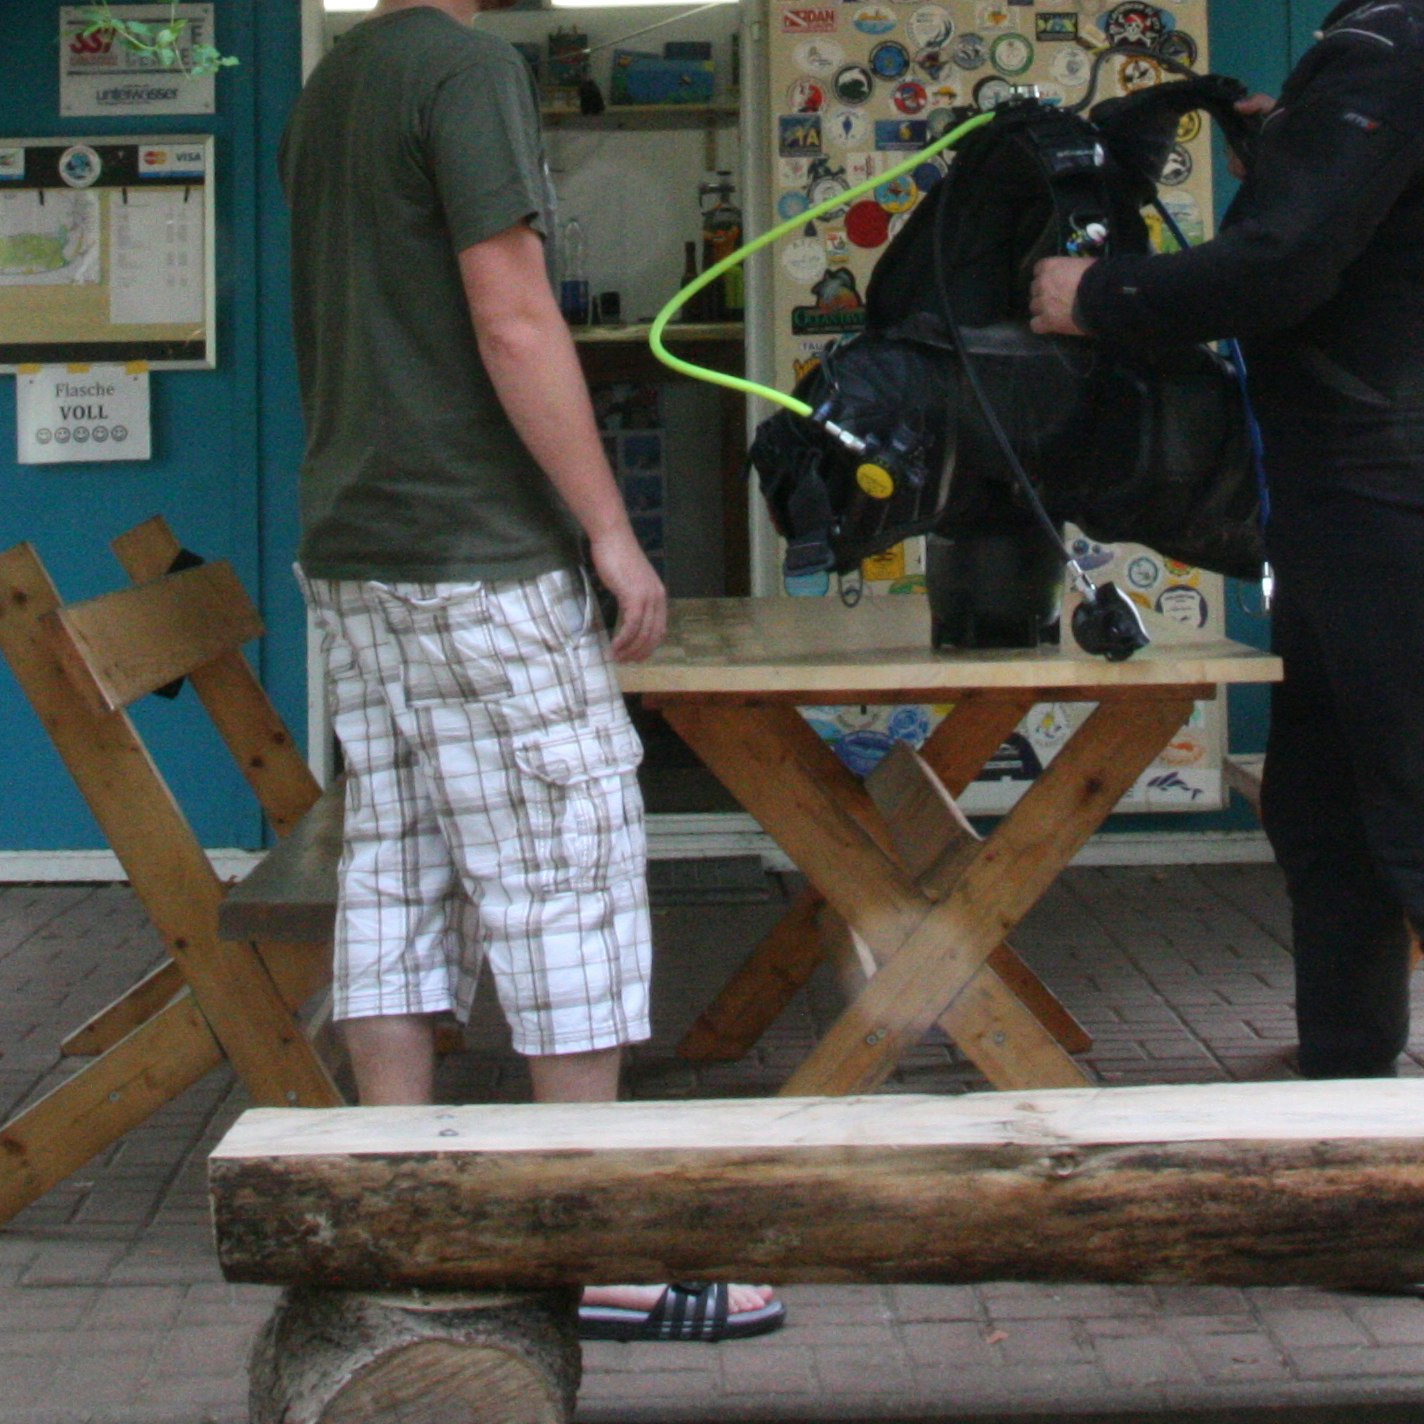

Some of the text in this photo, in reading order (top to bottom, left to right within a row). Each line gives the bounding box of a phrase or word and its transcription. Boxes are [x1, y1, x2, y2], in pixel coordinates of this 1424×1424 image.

[176, 151, 202, 162] VISA
[54, 381, 116, 398] Flasche
[58, 404, 109, 421] VOLL
